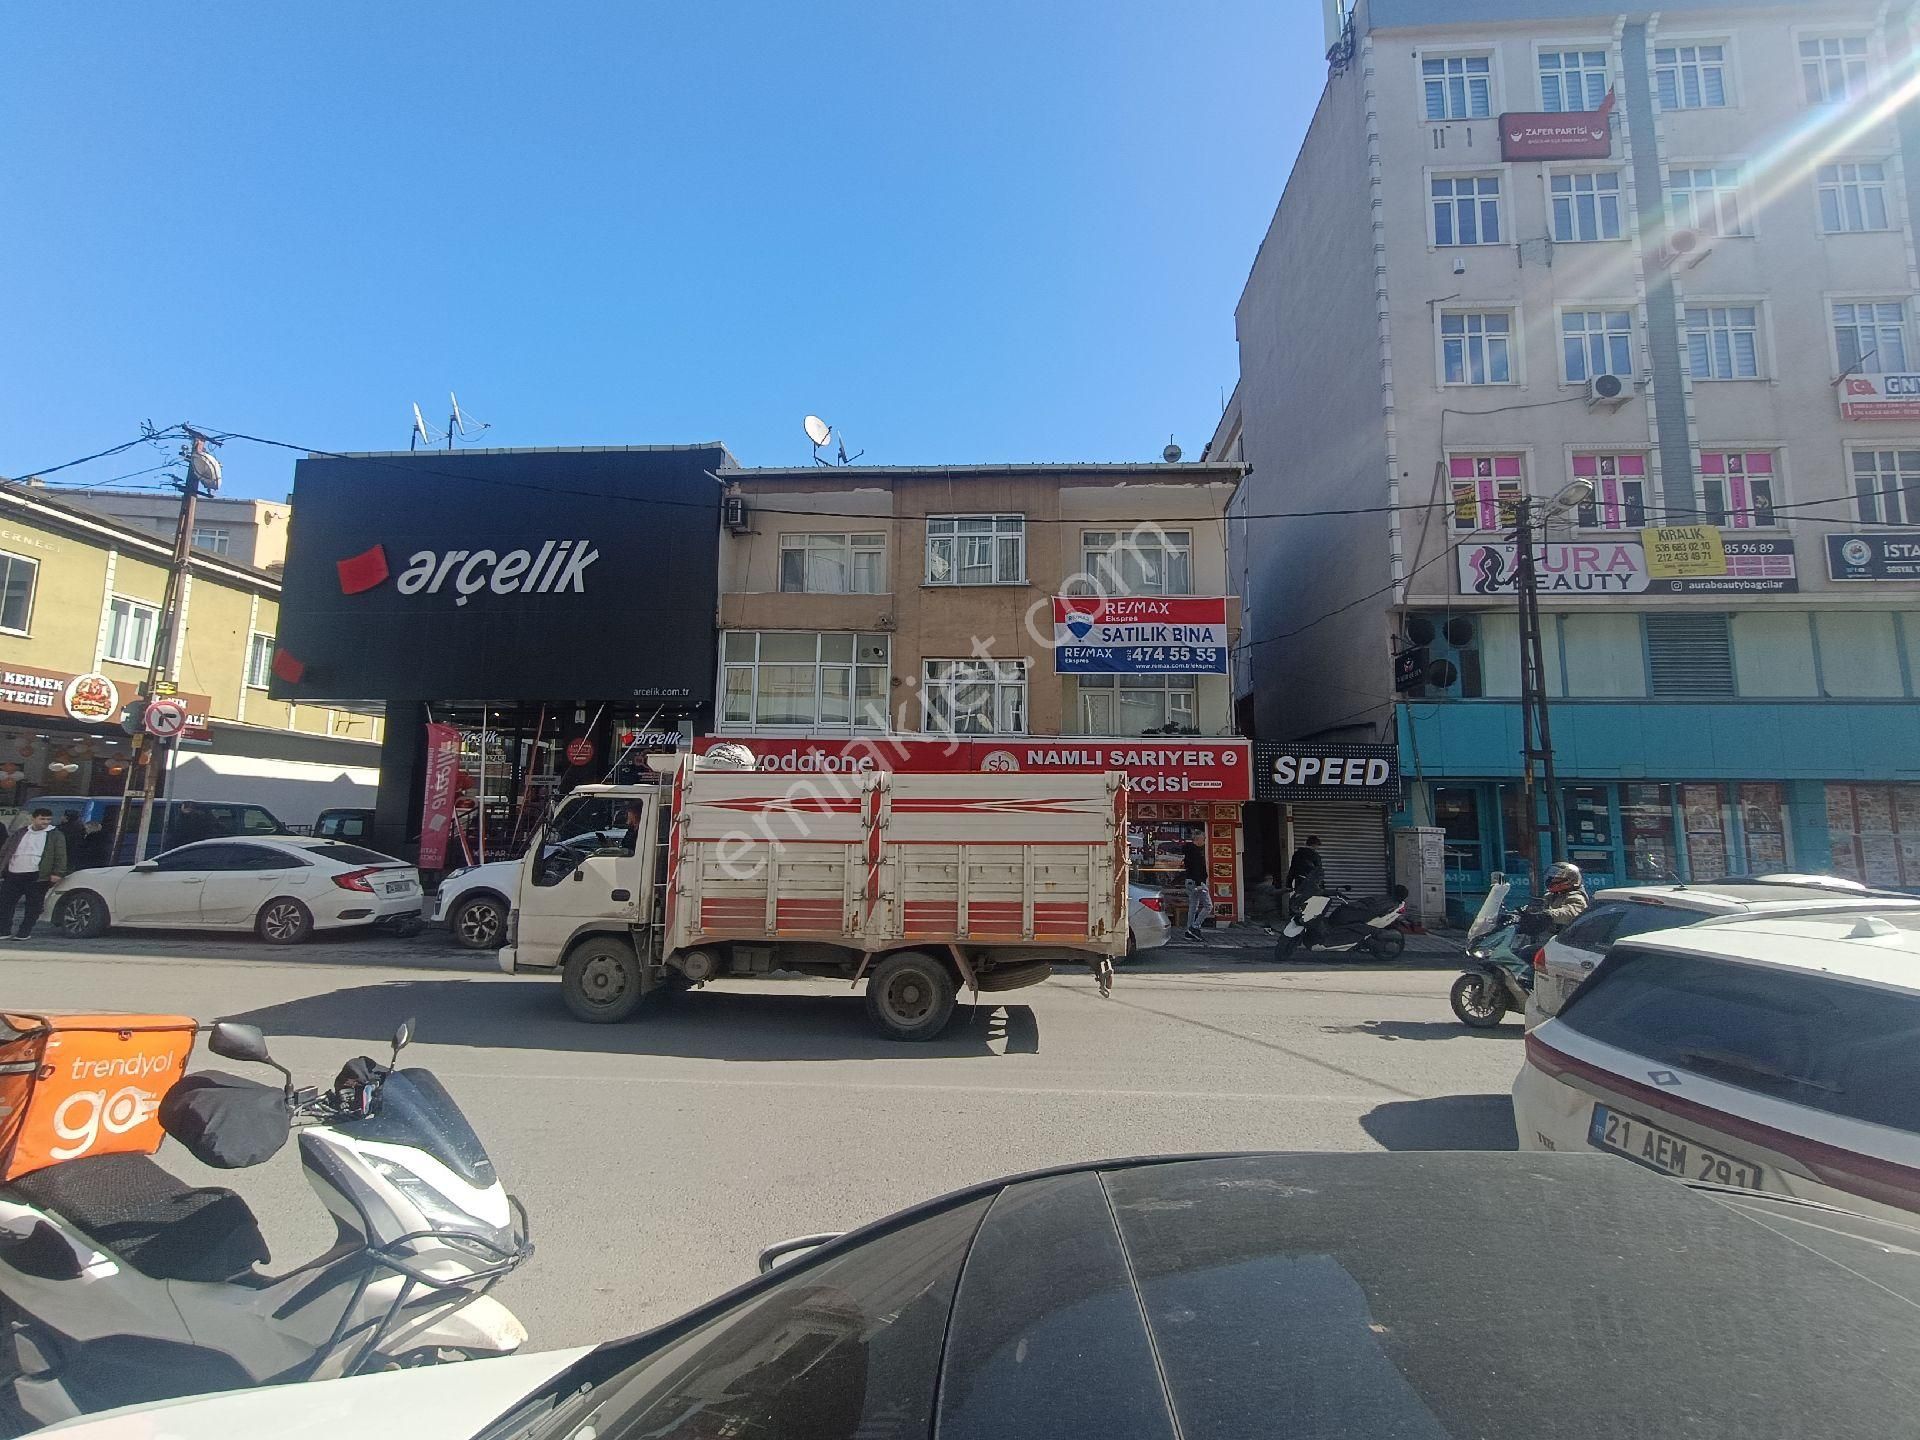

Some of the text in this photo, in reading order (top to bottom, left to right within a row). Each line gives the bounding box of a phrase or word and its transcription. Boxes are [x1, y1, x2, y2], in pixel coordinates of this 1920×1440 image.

[1555, 126, 1588, 135] PARTİSİ
[1657, 528, 1705, 541] KİRALIK
[1741, 543, 1757, 553] 96
[1759, 543, 1775, 553] 89
[1657, 553, 1672, 562] 212
[396, 540, 599, 606] arçelik
[1688, 580, 1783, 590] aurabeautybagcilar
[1105, 602, 1170, 615] RE/MAX
[1102, 625, 1214, 643] SATILIK BİNA
[1065, 648, 1113, 658] RE/MAX
[1132, 647, 1165, 661] 474
[1169, 648, 1190, 661] 55
[1195, 648, 1217, 662] 55
[4, 671, 64, 691] KERNEK
[633, 687, 690, 697] arcelik.com.tr
[634, 731, 683, 746] arçelik
[1028, 750, 1102, 765] NAMLI
[1109, 750, 1215, 766] SARIYER
[1273, 755, 1390, 785] SPEED
[71, 1051, 173, 1080] trendyol
[50, 1086, 160, 1160] go
[1605, 1115, 1746, 1188] 21 AEM 291
